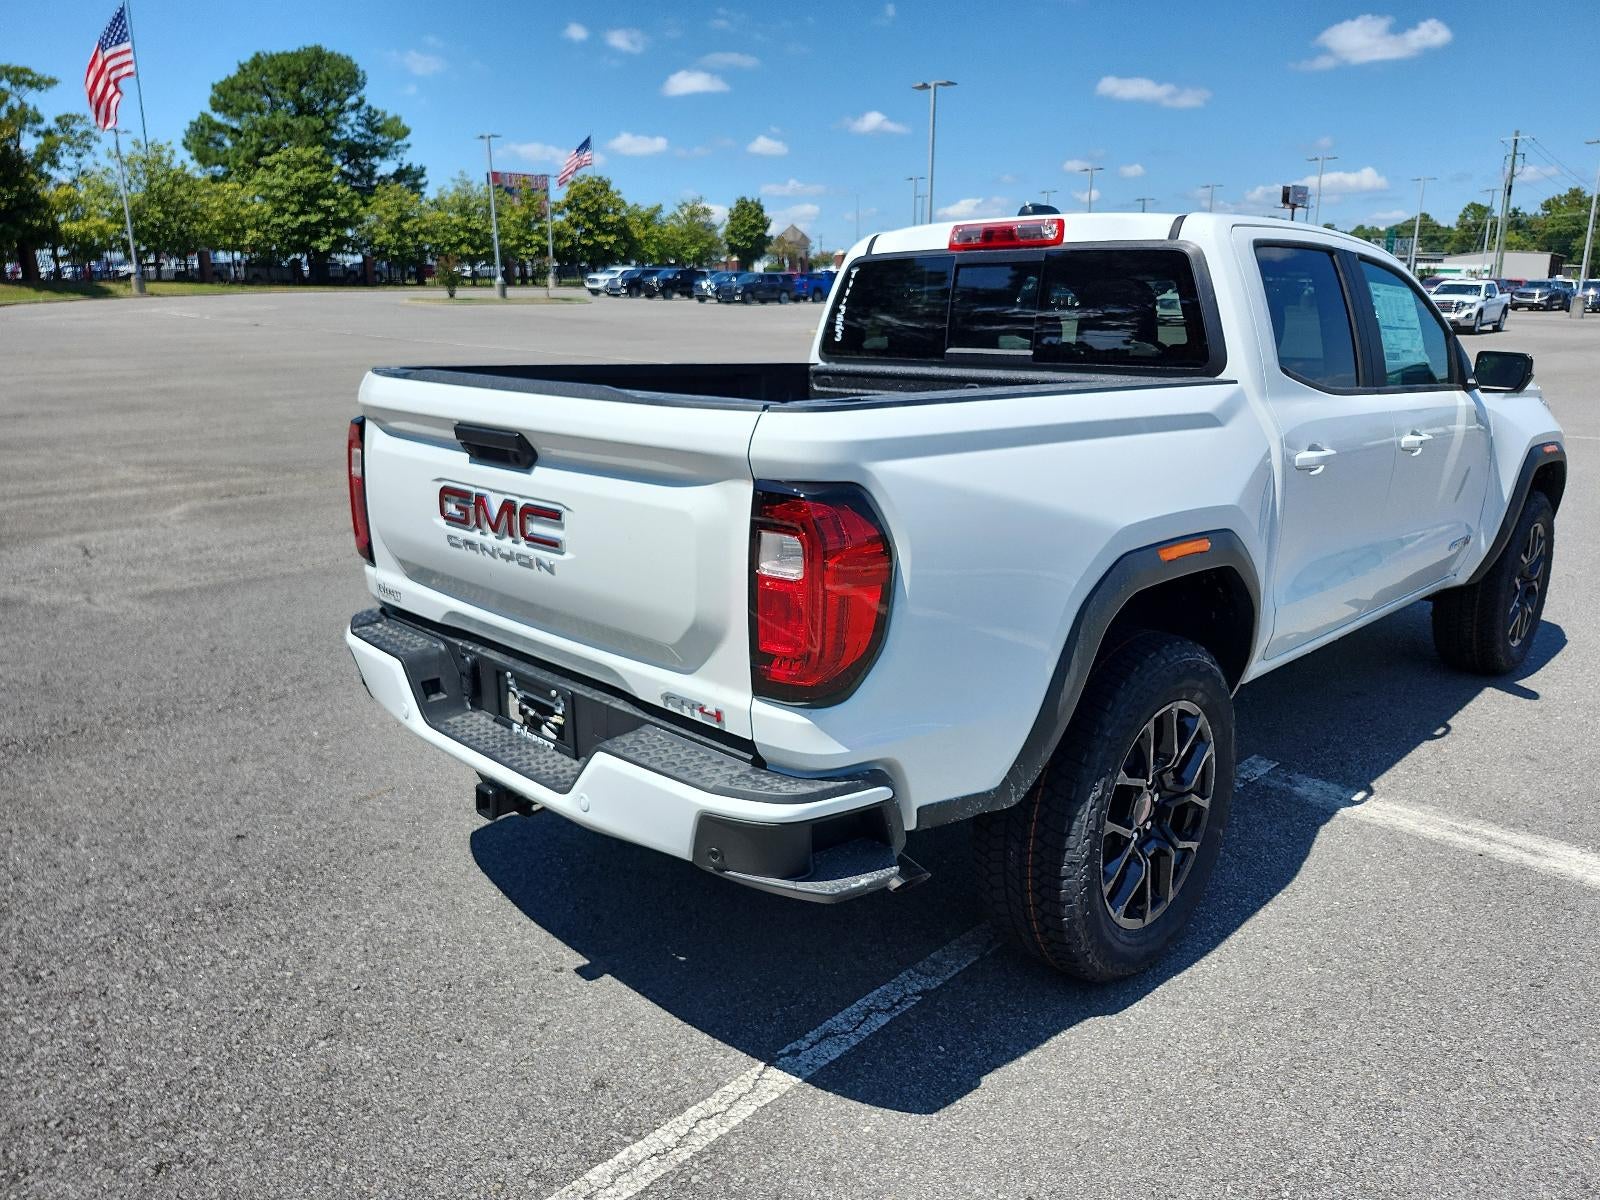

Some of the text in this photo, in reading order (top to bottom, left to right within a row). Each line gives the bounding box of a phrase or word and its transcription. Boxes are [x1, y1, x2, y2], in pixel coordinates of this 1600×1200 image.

[438, 484, 567, 556] GMC
[446, 534, 556, 576] CANYON
[660, 691, 726, 730] AT4
